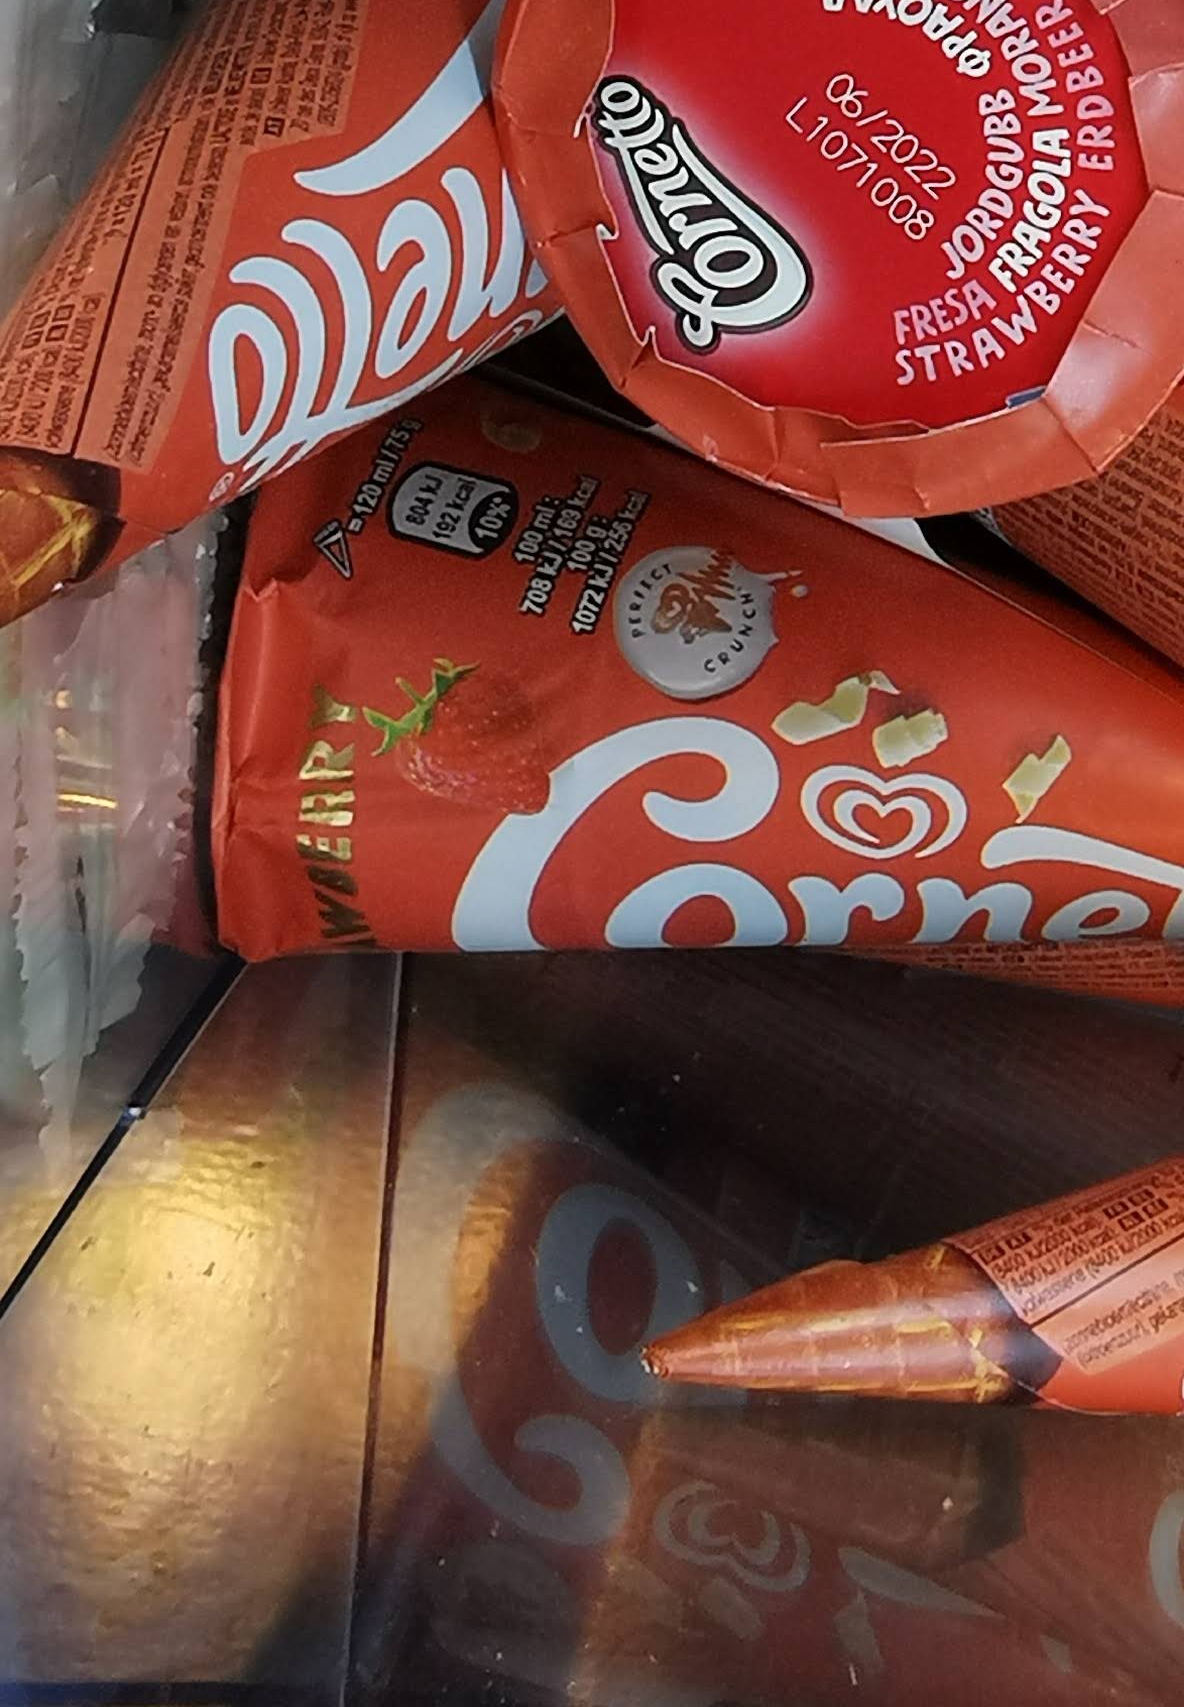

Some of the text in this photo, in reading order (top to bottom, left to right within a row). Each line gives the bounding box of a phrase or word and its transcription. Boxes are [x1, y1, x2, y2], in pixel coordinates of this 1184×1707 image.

[785, 95, 935, 242] L1071008
[824, 72, 957, 199] 06/2022
[938, 88, 1018, 281] JORDGUBB
[600, 76, 808, 347] Cornetto
[989, 126, 1072, 294] FRAGOLA
[893, 278, 998, 345] FRESA
[895, 189, 1112, 387] STRAWBERRY
[404, 492, 434, 528] 804
[431, 474, 478, 544] 192 kcal
[519, 574, 554, 617] 708
[569, 586, 606, 637] 1072
[626, 562, 673, 639] PERFECT
